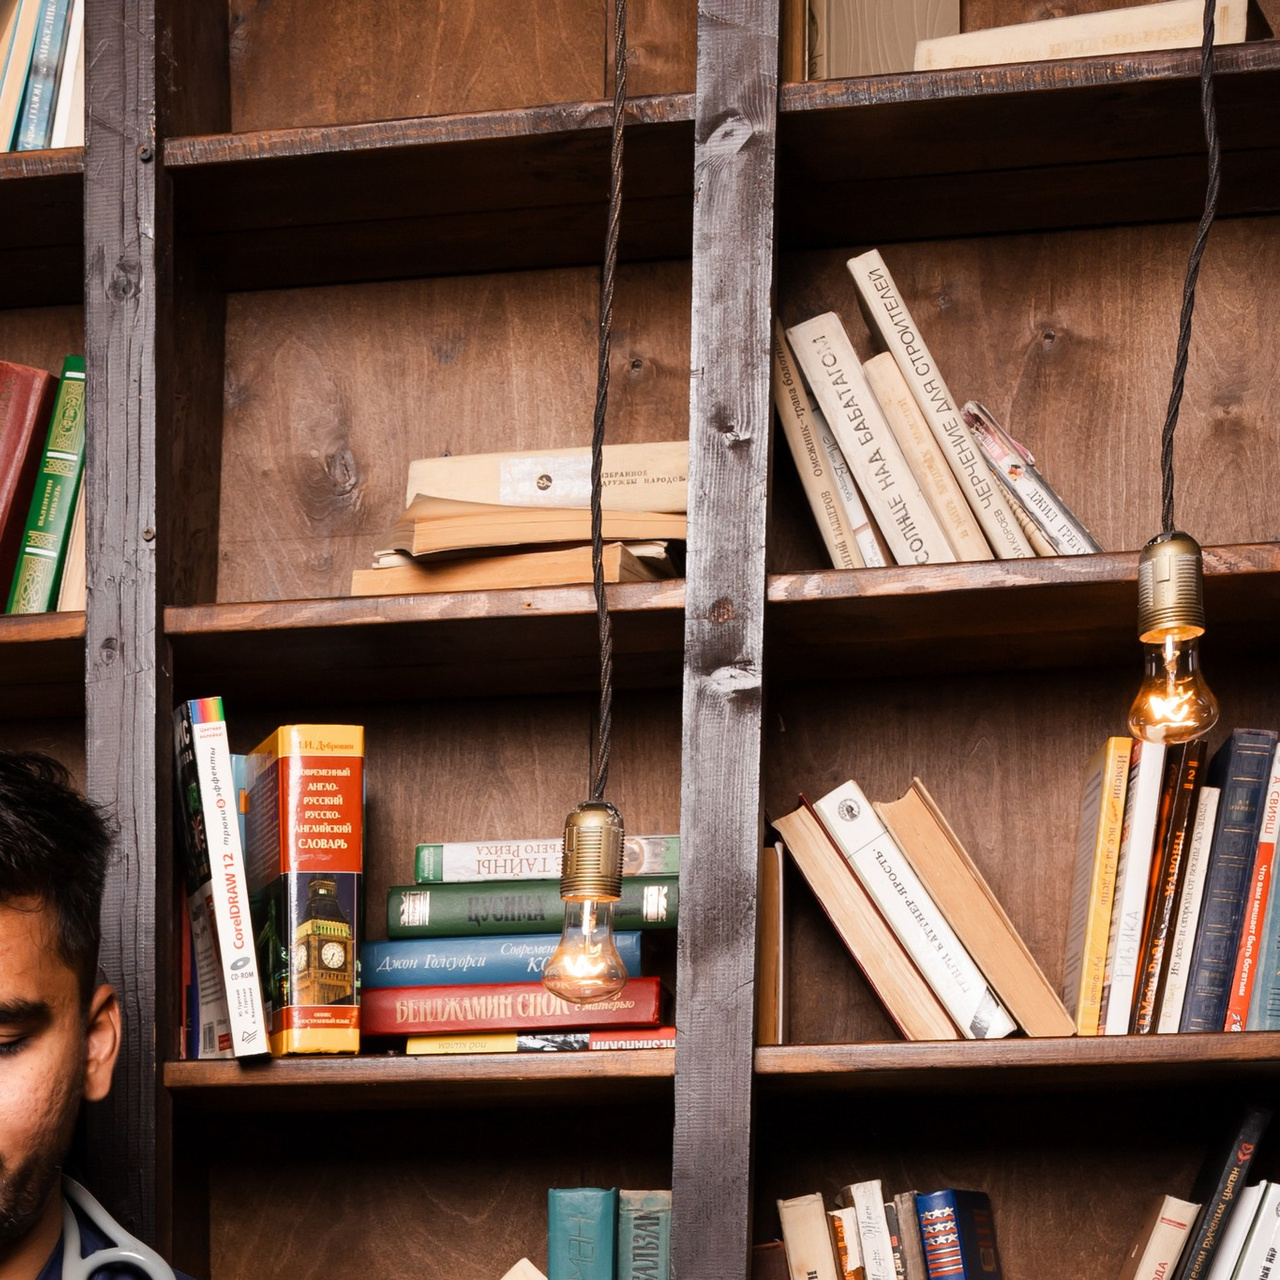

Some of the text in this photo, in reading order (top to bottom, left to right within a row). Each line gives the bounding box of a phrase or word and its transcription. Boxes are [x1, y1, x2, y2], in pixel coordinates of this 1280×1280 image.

[862, 265, 934, 379] СТРОИТЕЛЕЙ
[806, 333, 879, 445] БАБАТАГОМ
[920, 377, 952, 417] ДЛЯ
[863, 446, 898, 490] НАД
[939, 417, 999, 509] ЧЕРЧЕНИЕ
[37, 478, 55, 526] ВАЛЕНТИН
[1025, 486, 1058, 524] ДЖИЛ
[883, 492, 933, 565] СОЛНЦЕ
[206, 745, 233, 846] трюки эффекты
[307, 782, 339, 791] АНГЛО-
[1111, 754, 1127, 800] Измени
[303, 795, 343, 806] РУССКИЙ
[304, 810, 341, 819] РУССКО-
[1263, 789, 1279, 835] СВИЯШ
[295, 823, 352, 834] АНГЛИЙСКИЙ
[298, 838, 348, 849] СЛОВАРЬ
[475, 856, 548, 878] ТАЙНЫ
[1102, 862, 1114, 875] 21
[1164, 829, 1186, 895] МАРОНЫ
[219, 851, 246, 950] CorelDRAW 12
[466, 894, 546, 925] ЦУСИМА
[1114, 909, 1140, 983] ФИЗИКА
[1236, 863, 1267, 996] Что вам мешает быть богатым
[230, 971, 255, 982] CD-ROM
[375, 953, 487, 974] Джон Голсуорси
[395, 991, 570, 1024] БЕНДЖАМИН СПОК
[582, 997, 636, 1013] матерью
[1202, 1200, 1230, 1250] русских
[1221, 1164, 1244, 1202] цыган
[1263, 1245, 1280, 1264] МИР
